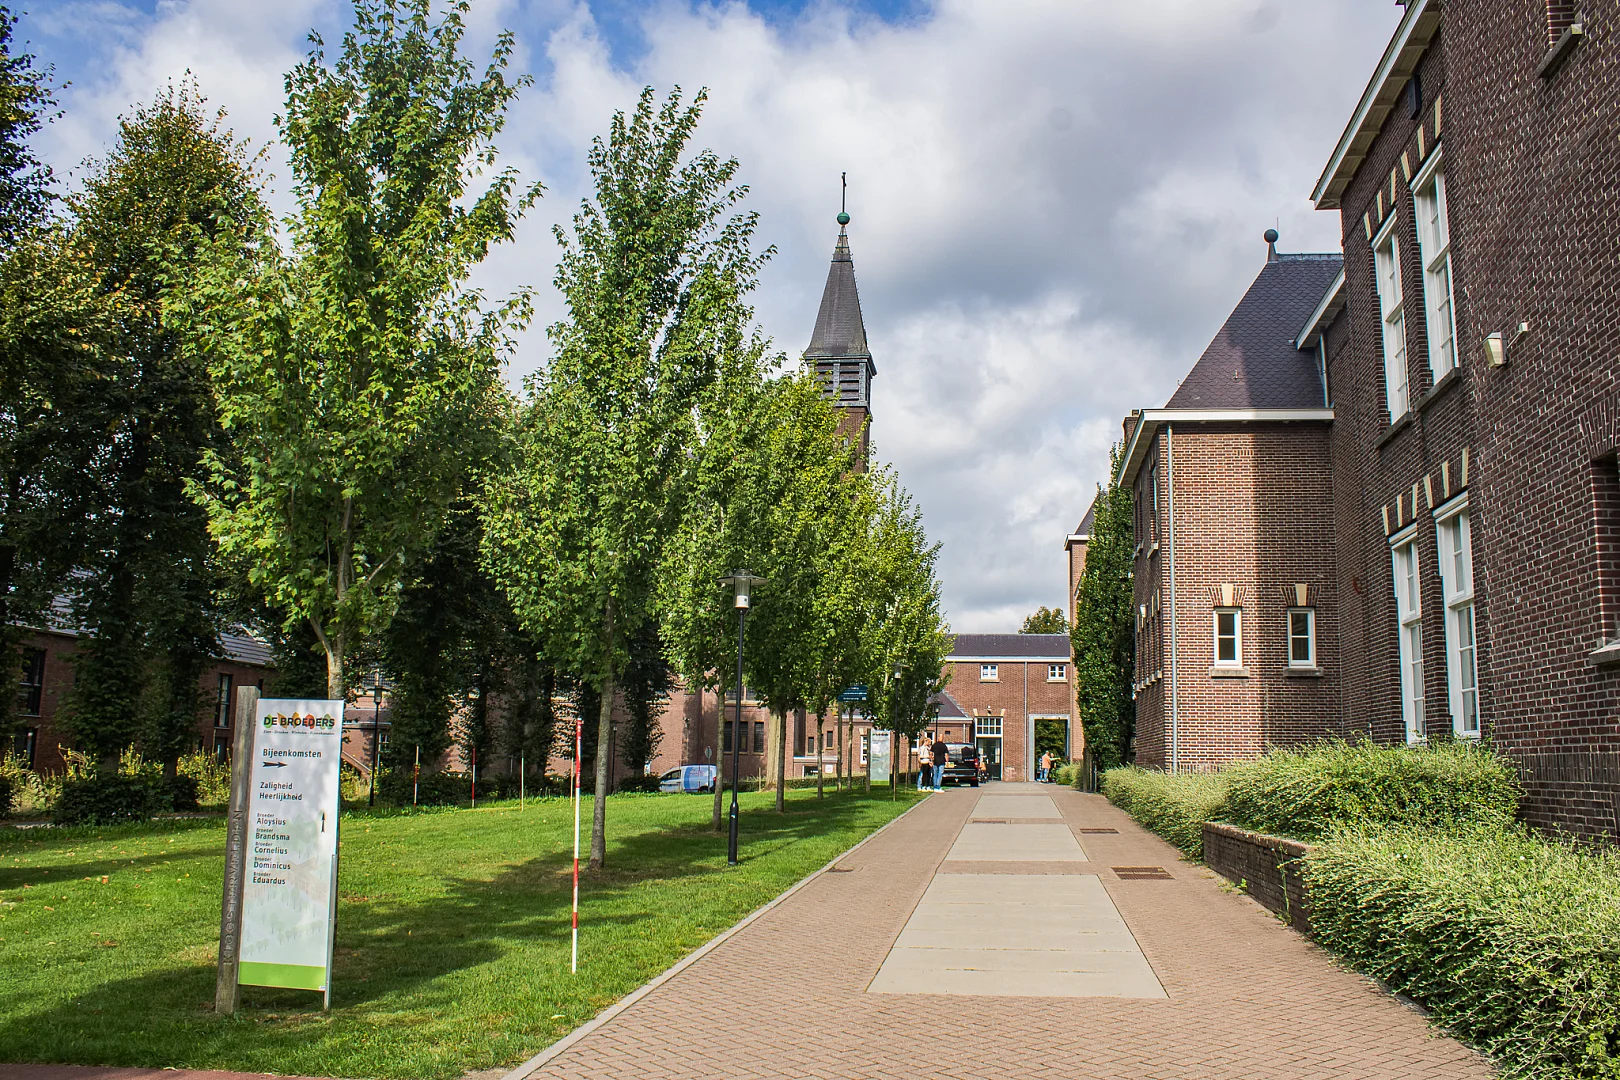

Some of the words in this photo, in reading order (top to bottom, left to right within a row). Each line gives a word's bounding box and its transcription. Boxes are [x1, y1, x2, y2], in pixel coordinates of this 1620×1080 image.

[263, 716, 278, 726] DE
[280, 717, 335, 726] BROEDERS
[263, 748, 322, 758] Bijeenkomsten
[260, 782, 293, 791] Zaligheid
[260, 792, 302, 801] Heerlijkheid
[257, 818, 286, 826] Aloysius
[252, 876, 286, 884] Eduardus
